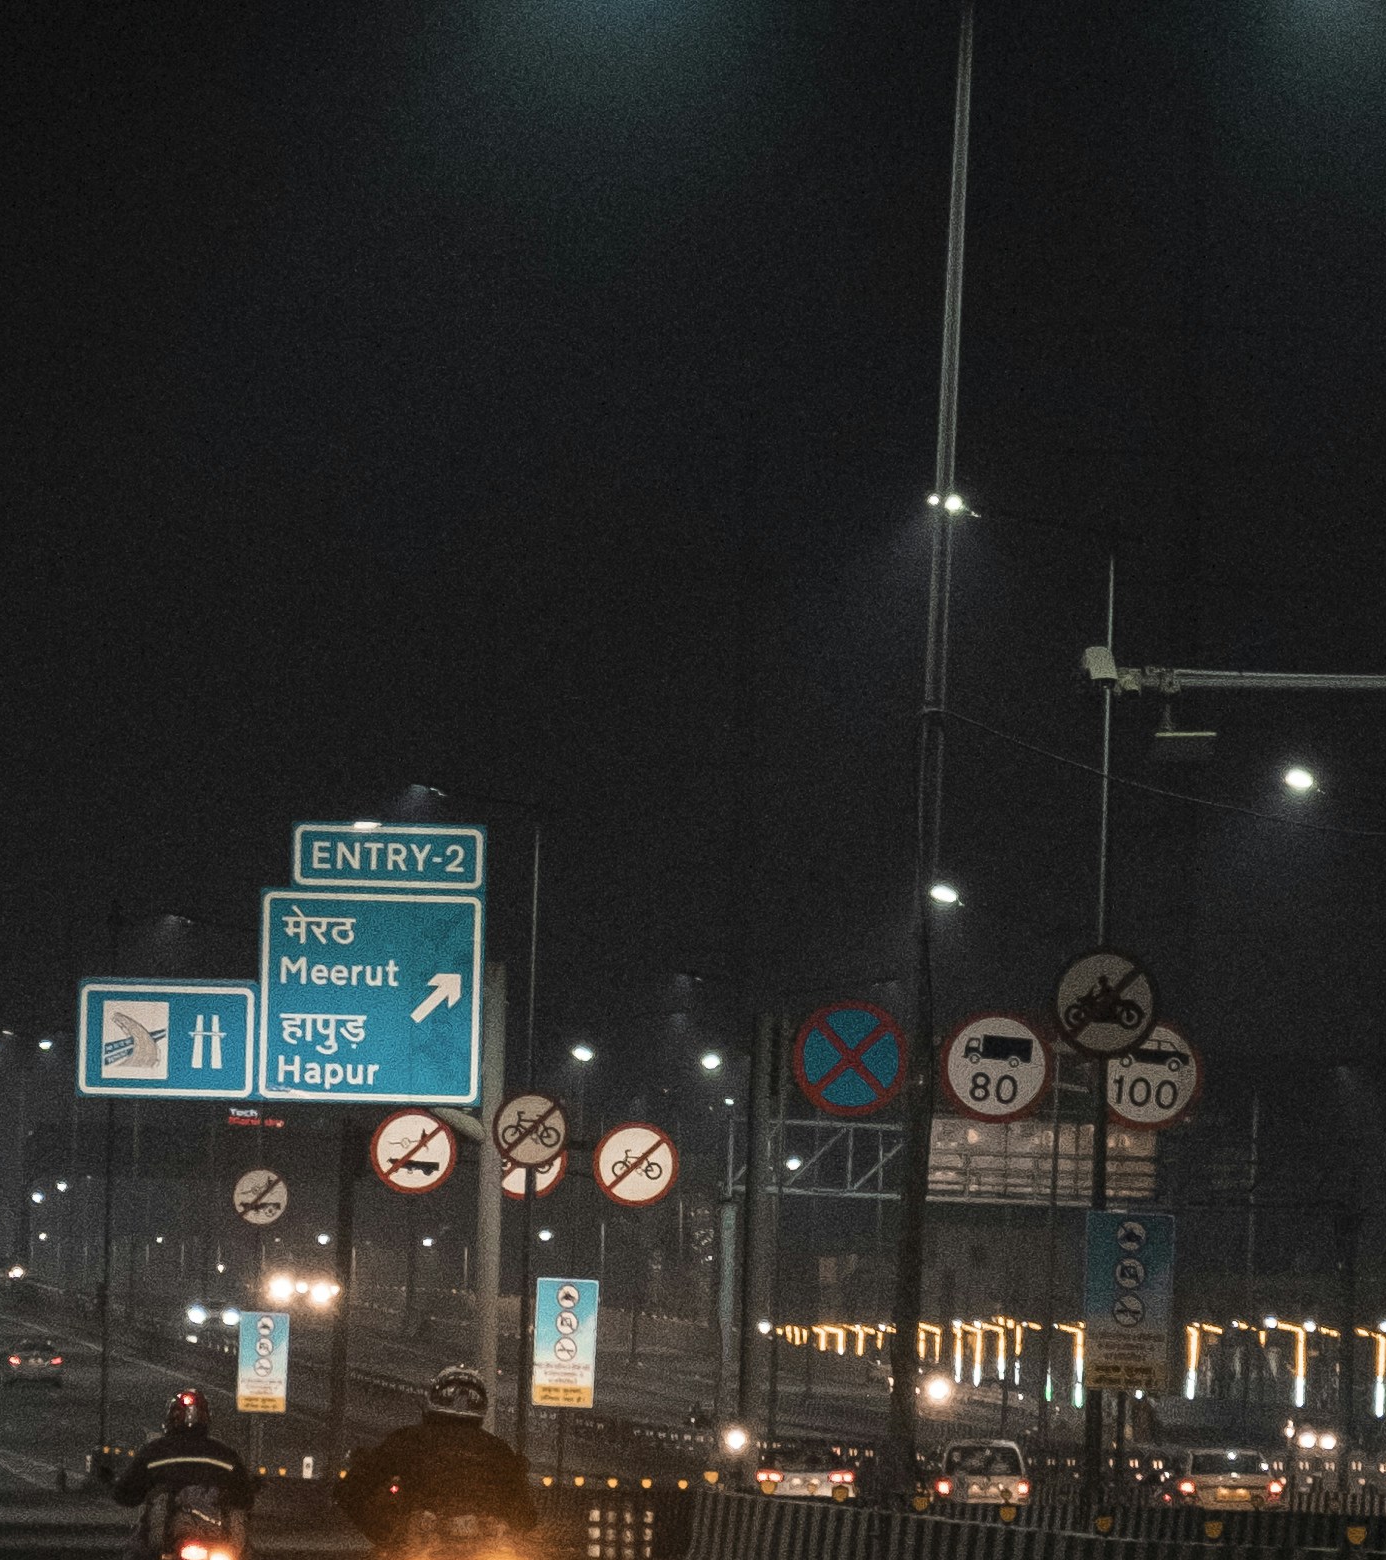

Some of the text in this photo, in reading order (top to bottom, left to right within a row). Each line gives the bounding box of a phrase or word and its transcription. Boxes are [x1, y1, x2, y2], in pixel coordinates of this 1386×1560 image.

[312, 840, 464, 873] ENTRY-2
[282, 905, 356, 945] मेरठ
[279, 956, 400, 987] Meerut
[279, 1013, 367, 1054] हापुड़
[277, 1055, 380, 1089] Hapur
[969, 1071, 1018, 1105] 80
[1114, 1074, 1179, 1110] 100
